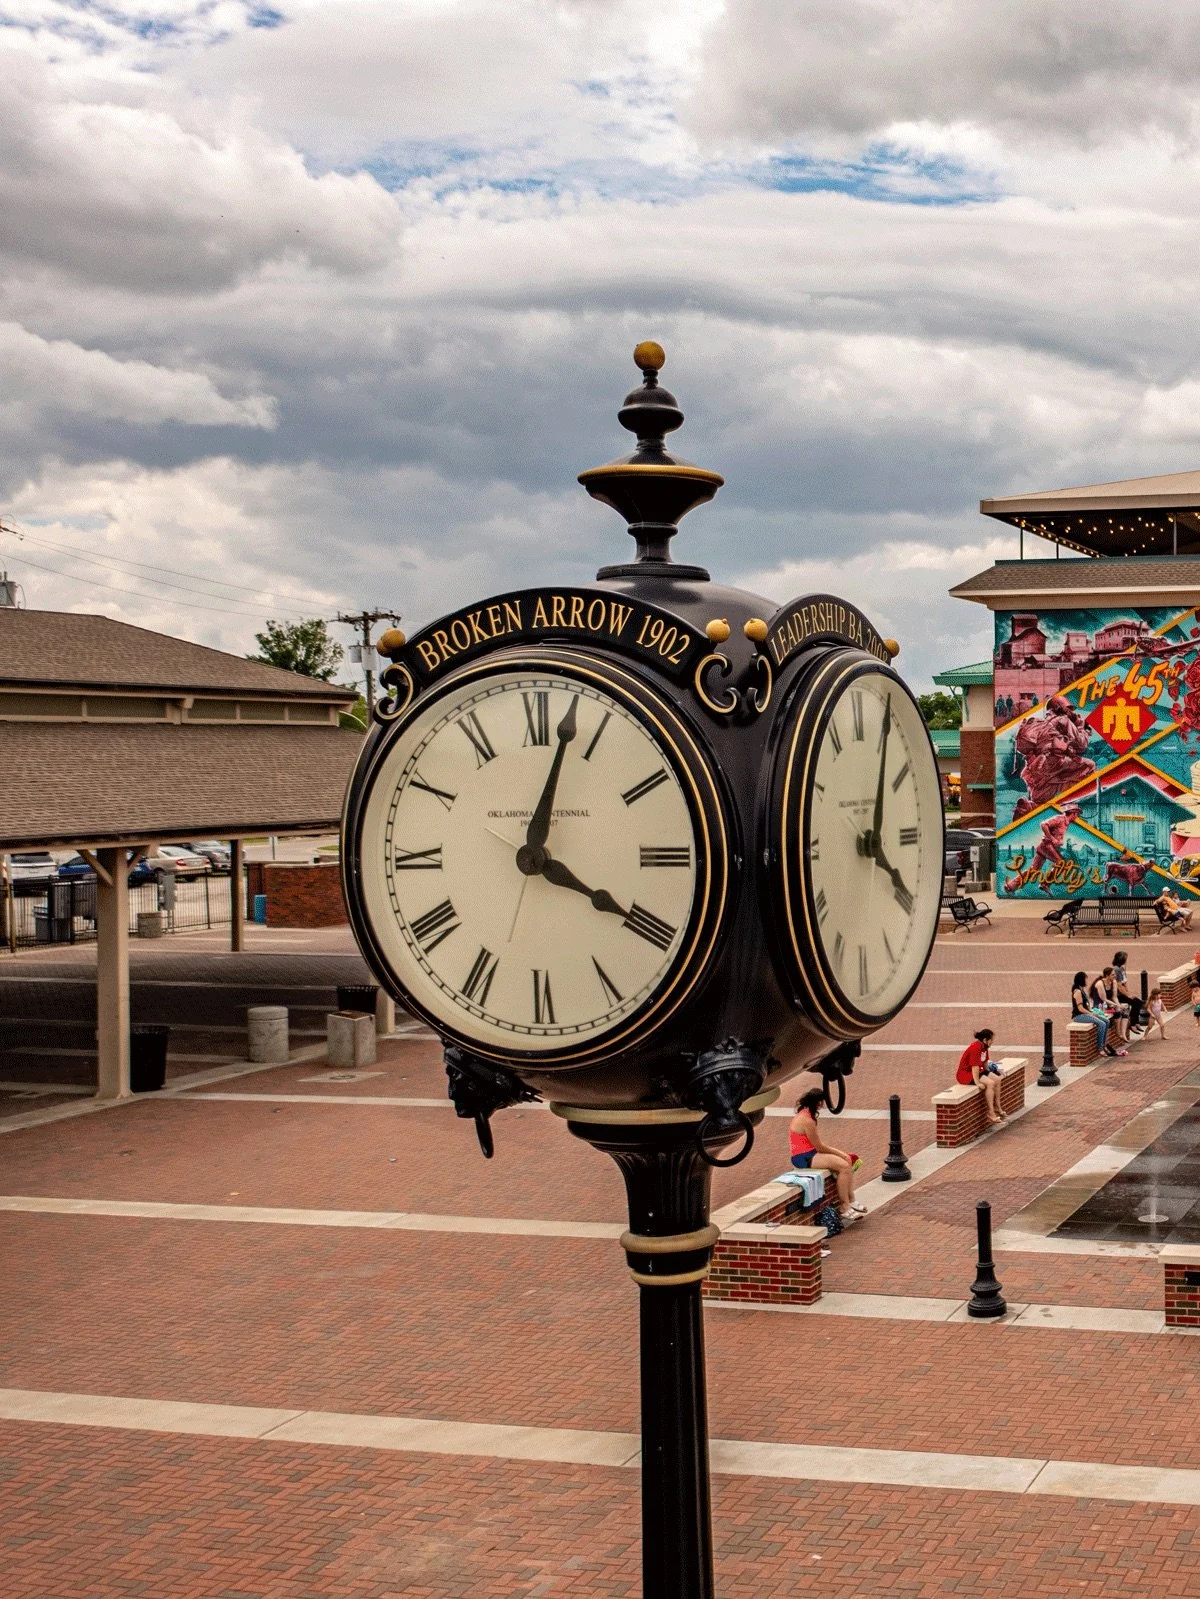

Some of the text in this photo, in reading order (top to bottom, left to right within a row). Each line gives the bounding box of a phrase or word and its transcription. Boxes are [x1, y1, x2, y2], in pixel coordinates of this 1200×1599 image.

[416, 596, 691, 672] BROKEN ARROW 1902
[771, 602, 845, 666] LEADERSHIP
[849, 611, 863, 647] BA
[521, 692, 552, 748] XII
[1076, 676, 1120, 708] THE
[455, 708, 499, 770] XI
[487, 810, 535, 819] OKLAHOMA
